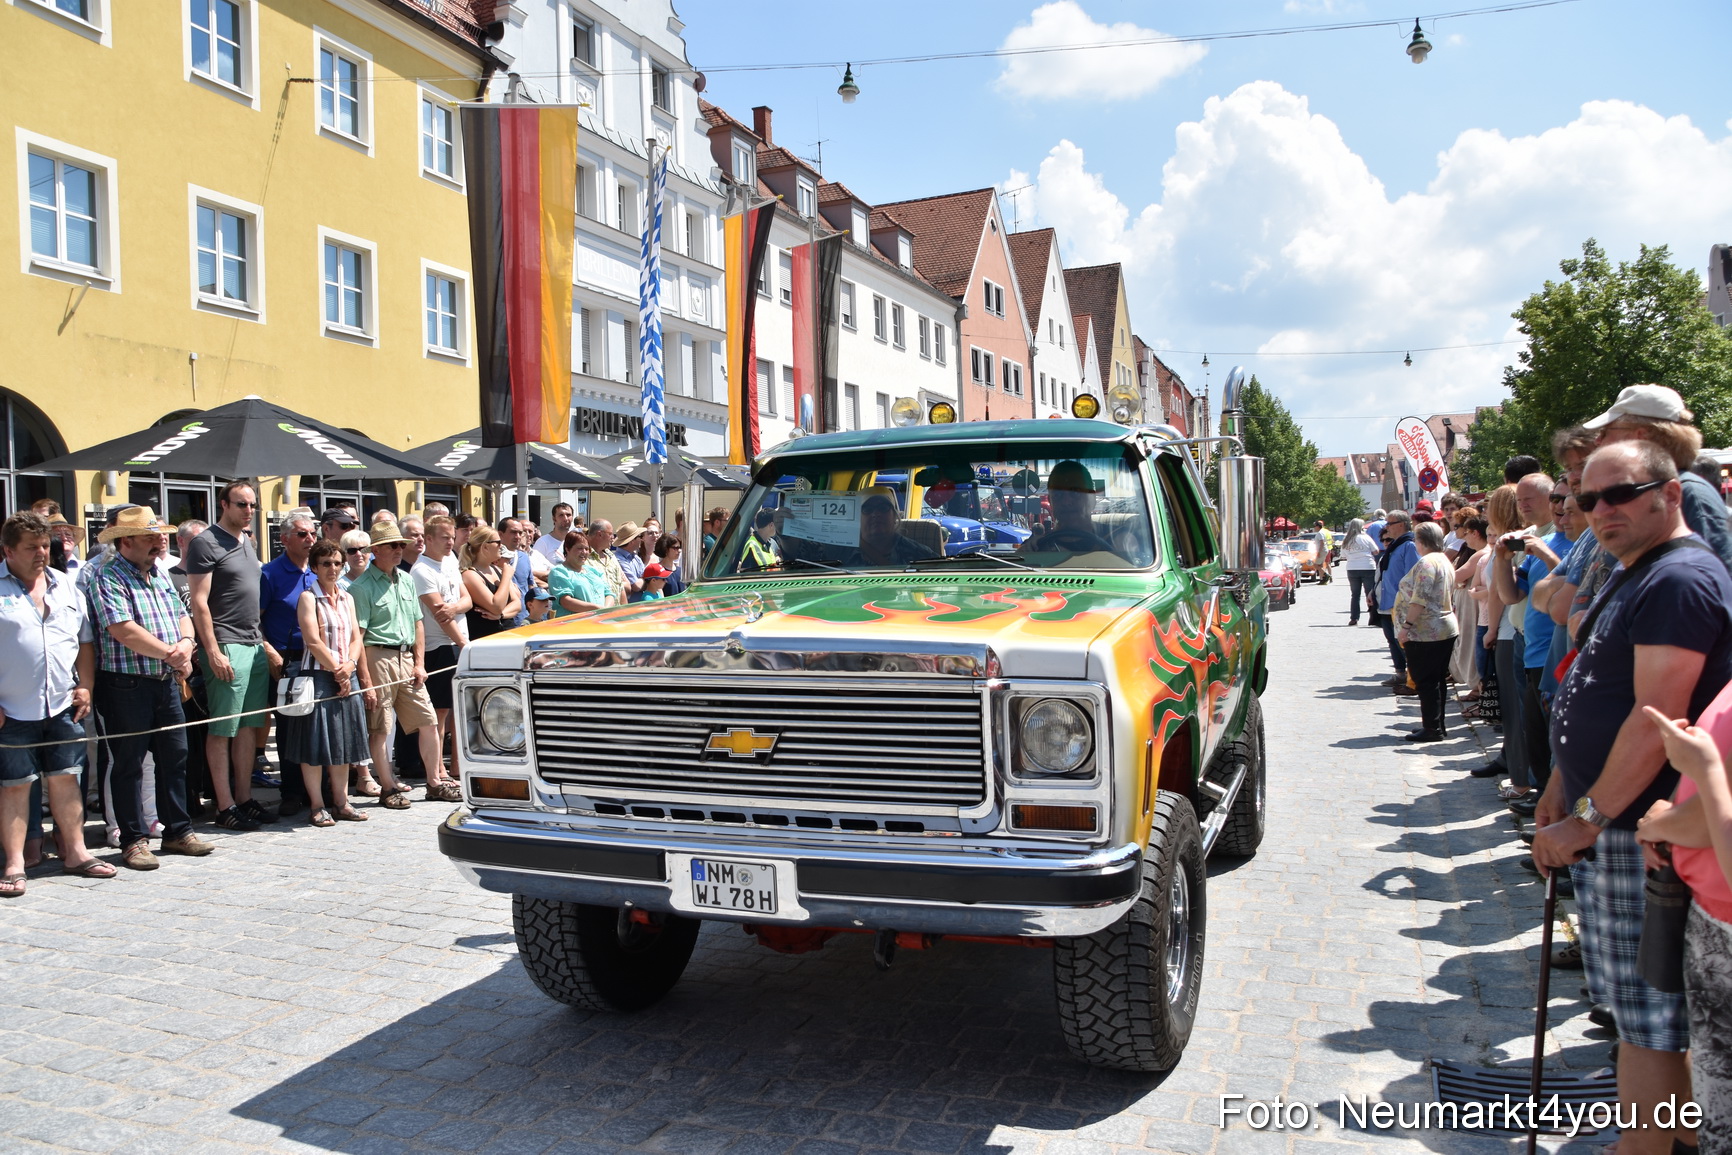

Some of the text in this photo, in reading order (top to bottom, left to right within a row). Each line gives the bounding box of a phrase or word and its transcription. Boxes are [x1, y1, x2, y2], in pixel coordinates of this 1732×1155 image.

[576, 406, 688, 446] BRILLENBER
[131, 425, 211, 461] now
[287, 427, 362, 465] now
[474, 496, 482, 508] 24
[821, 503, 846, 516] 124
[696, 872, 702, 880] D
[707, 863, 734, 884] NM
[696, 884, 721, 906] WI
